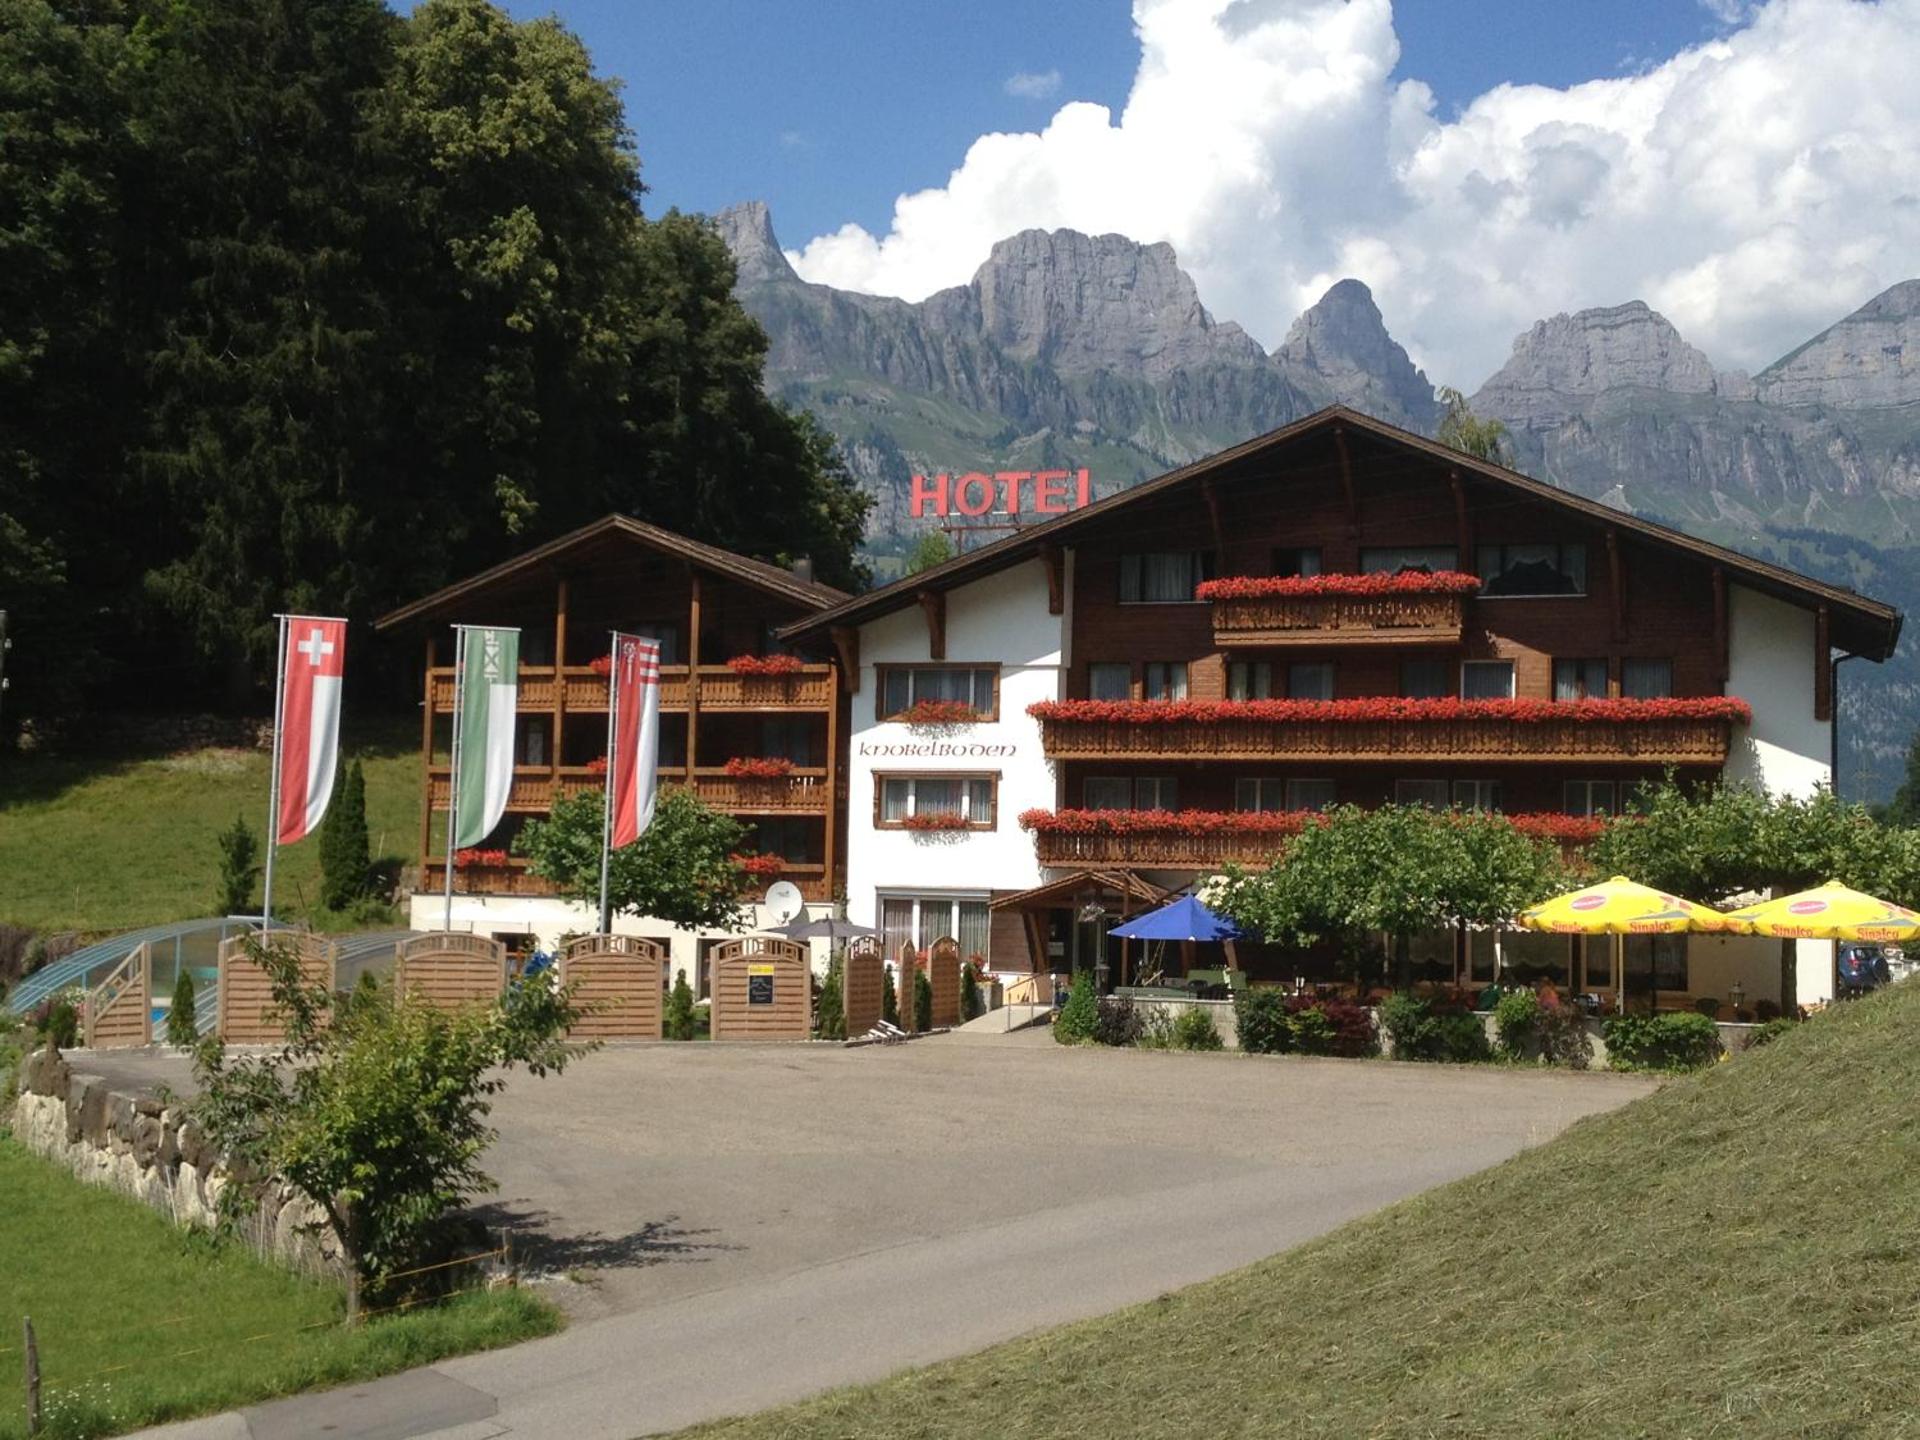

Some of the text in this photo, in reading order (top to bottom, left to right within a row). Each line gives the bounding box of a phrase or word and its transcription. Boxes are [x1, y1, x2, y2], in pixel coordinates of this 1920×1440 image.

[1629, 921, 1672, 934] Sinalco
[1771, 924, 1813, 937] Sinalco
[1856, 927, 1900, 941] Sinalco
